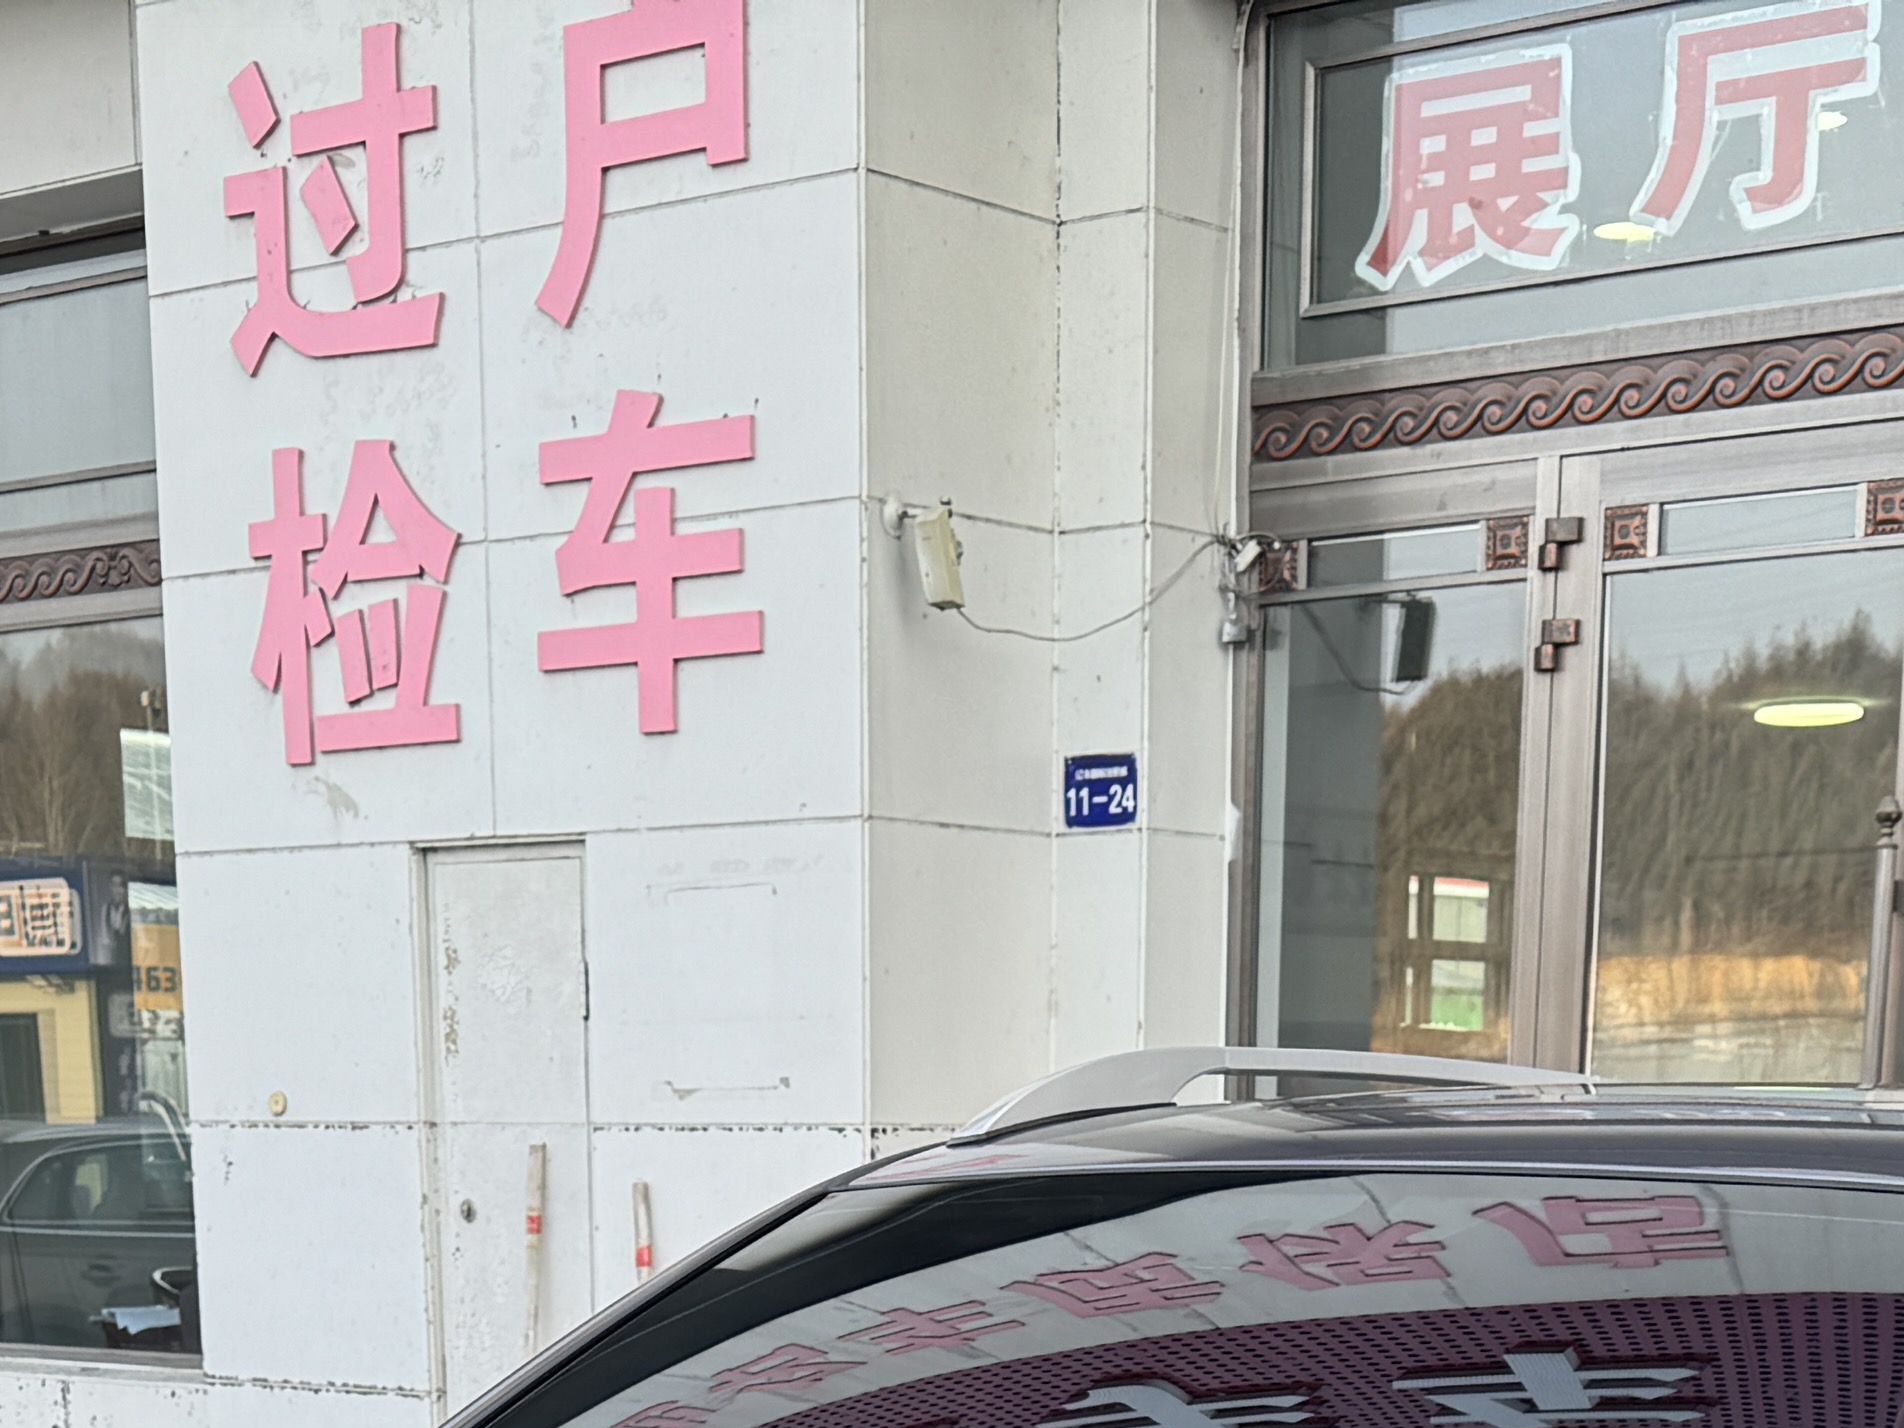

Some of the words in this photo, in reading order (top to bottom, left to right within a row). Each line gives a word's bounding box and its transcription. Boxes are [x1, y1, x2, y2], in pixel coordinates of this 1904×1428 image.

[223, 0, 750, 378] 过户
[1355, 0, 1882, 291] 展厅
[248, 388, 764, 765] 检车
[1066, 783, 1135, 817] 11-24
